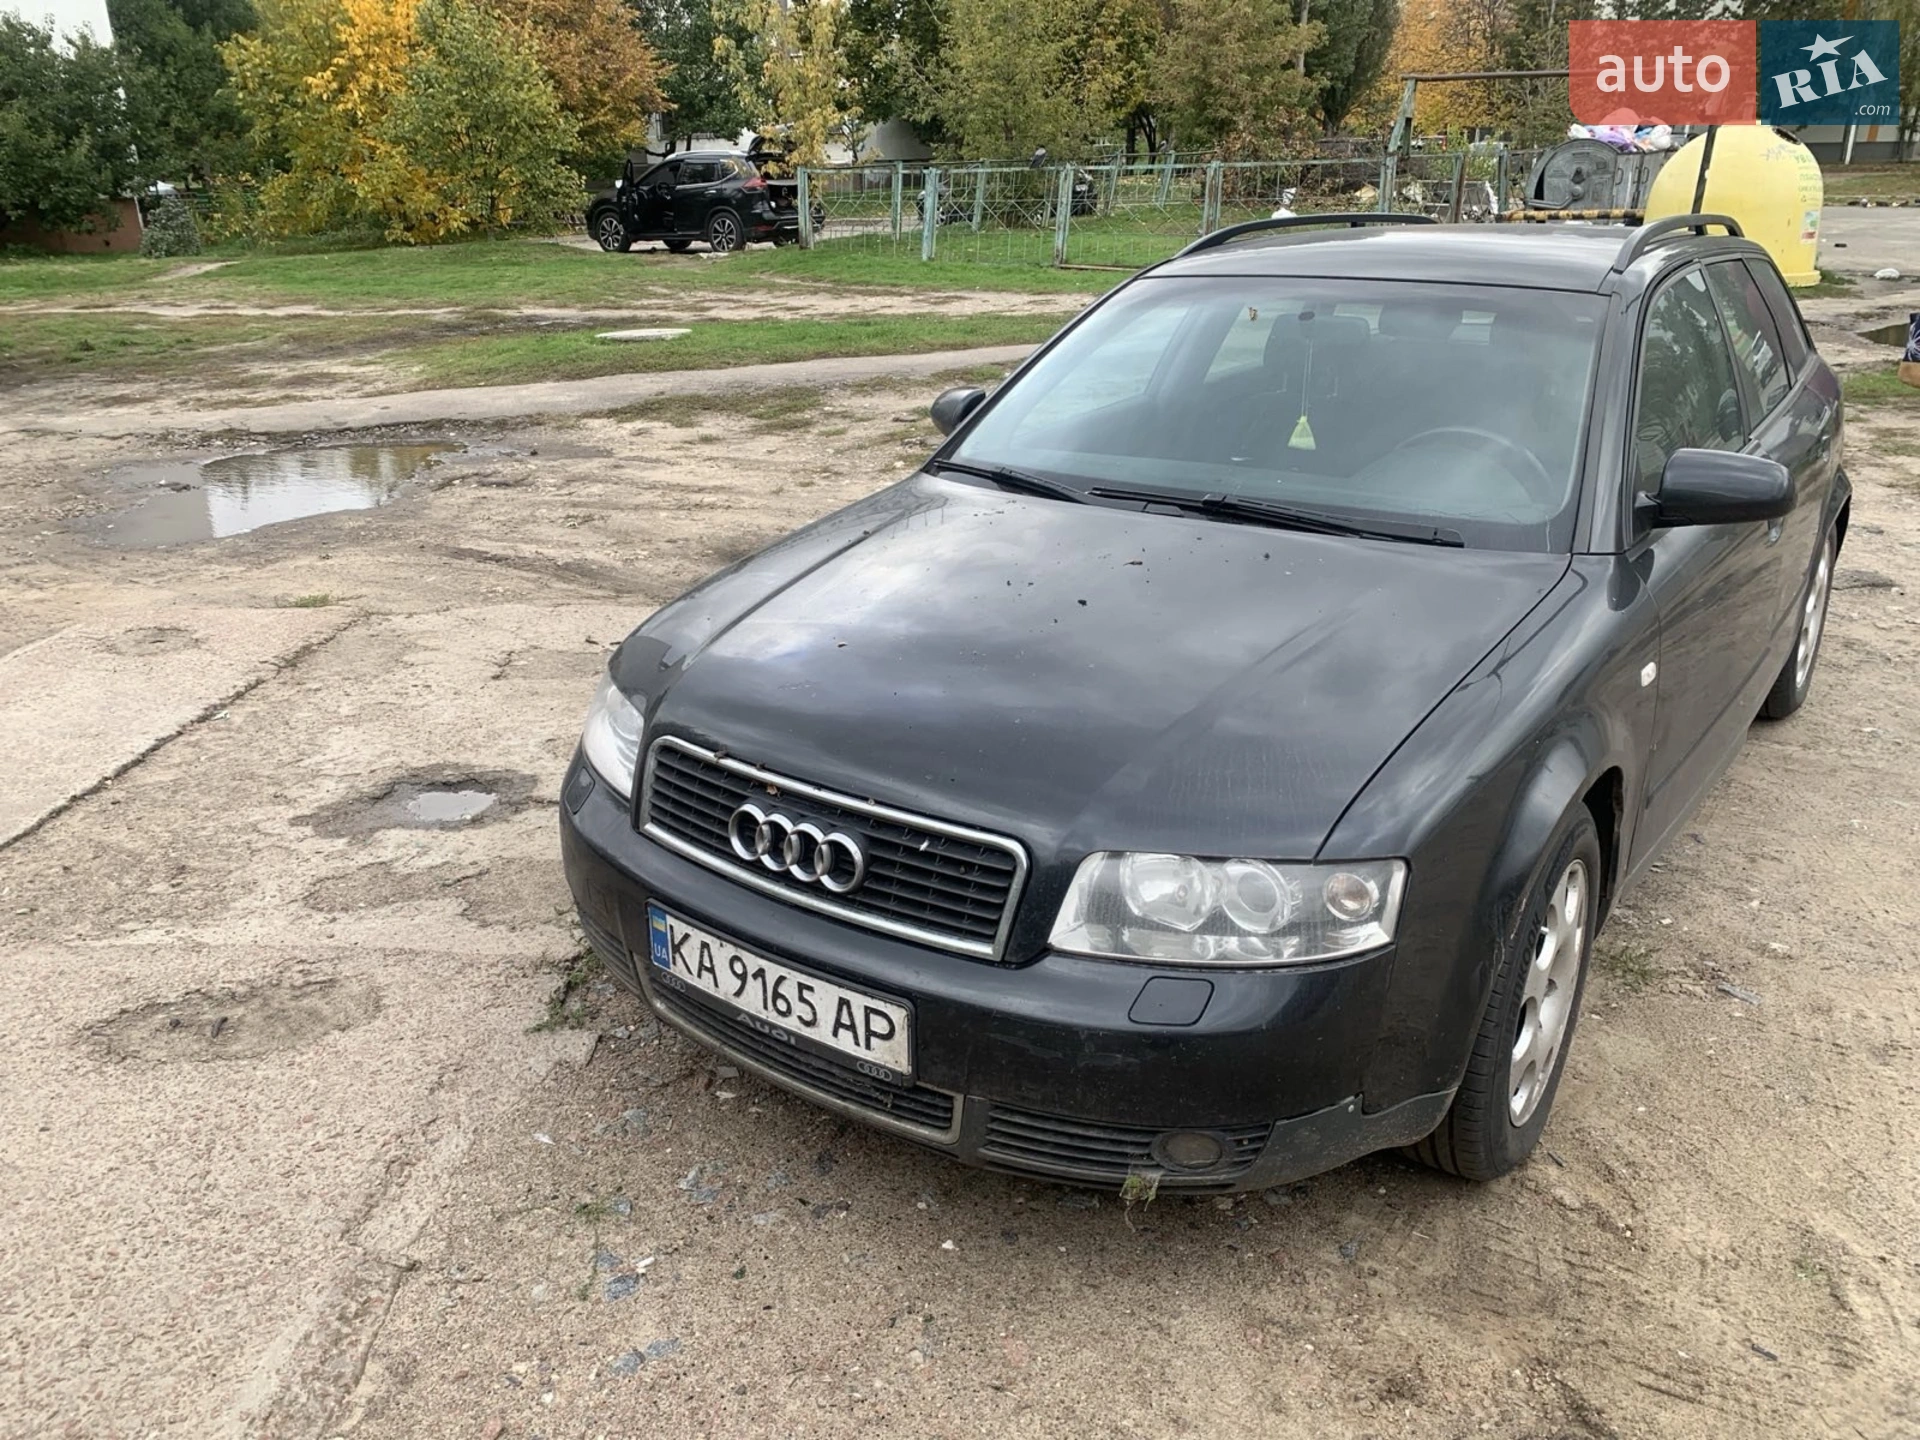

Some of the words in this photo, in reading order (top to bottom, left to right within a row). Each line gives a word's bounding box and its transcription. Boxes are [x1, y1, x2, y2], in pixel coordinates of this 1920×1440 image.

[654, 943, 669, 961] UA
[669, 923, 720, 989] KA
[729, 954, 818, 1028] 9165
[831, 996, 896, 1051] AP
